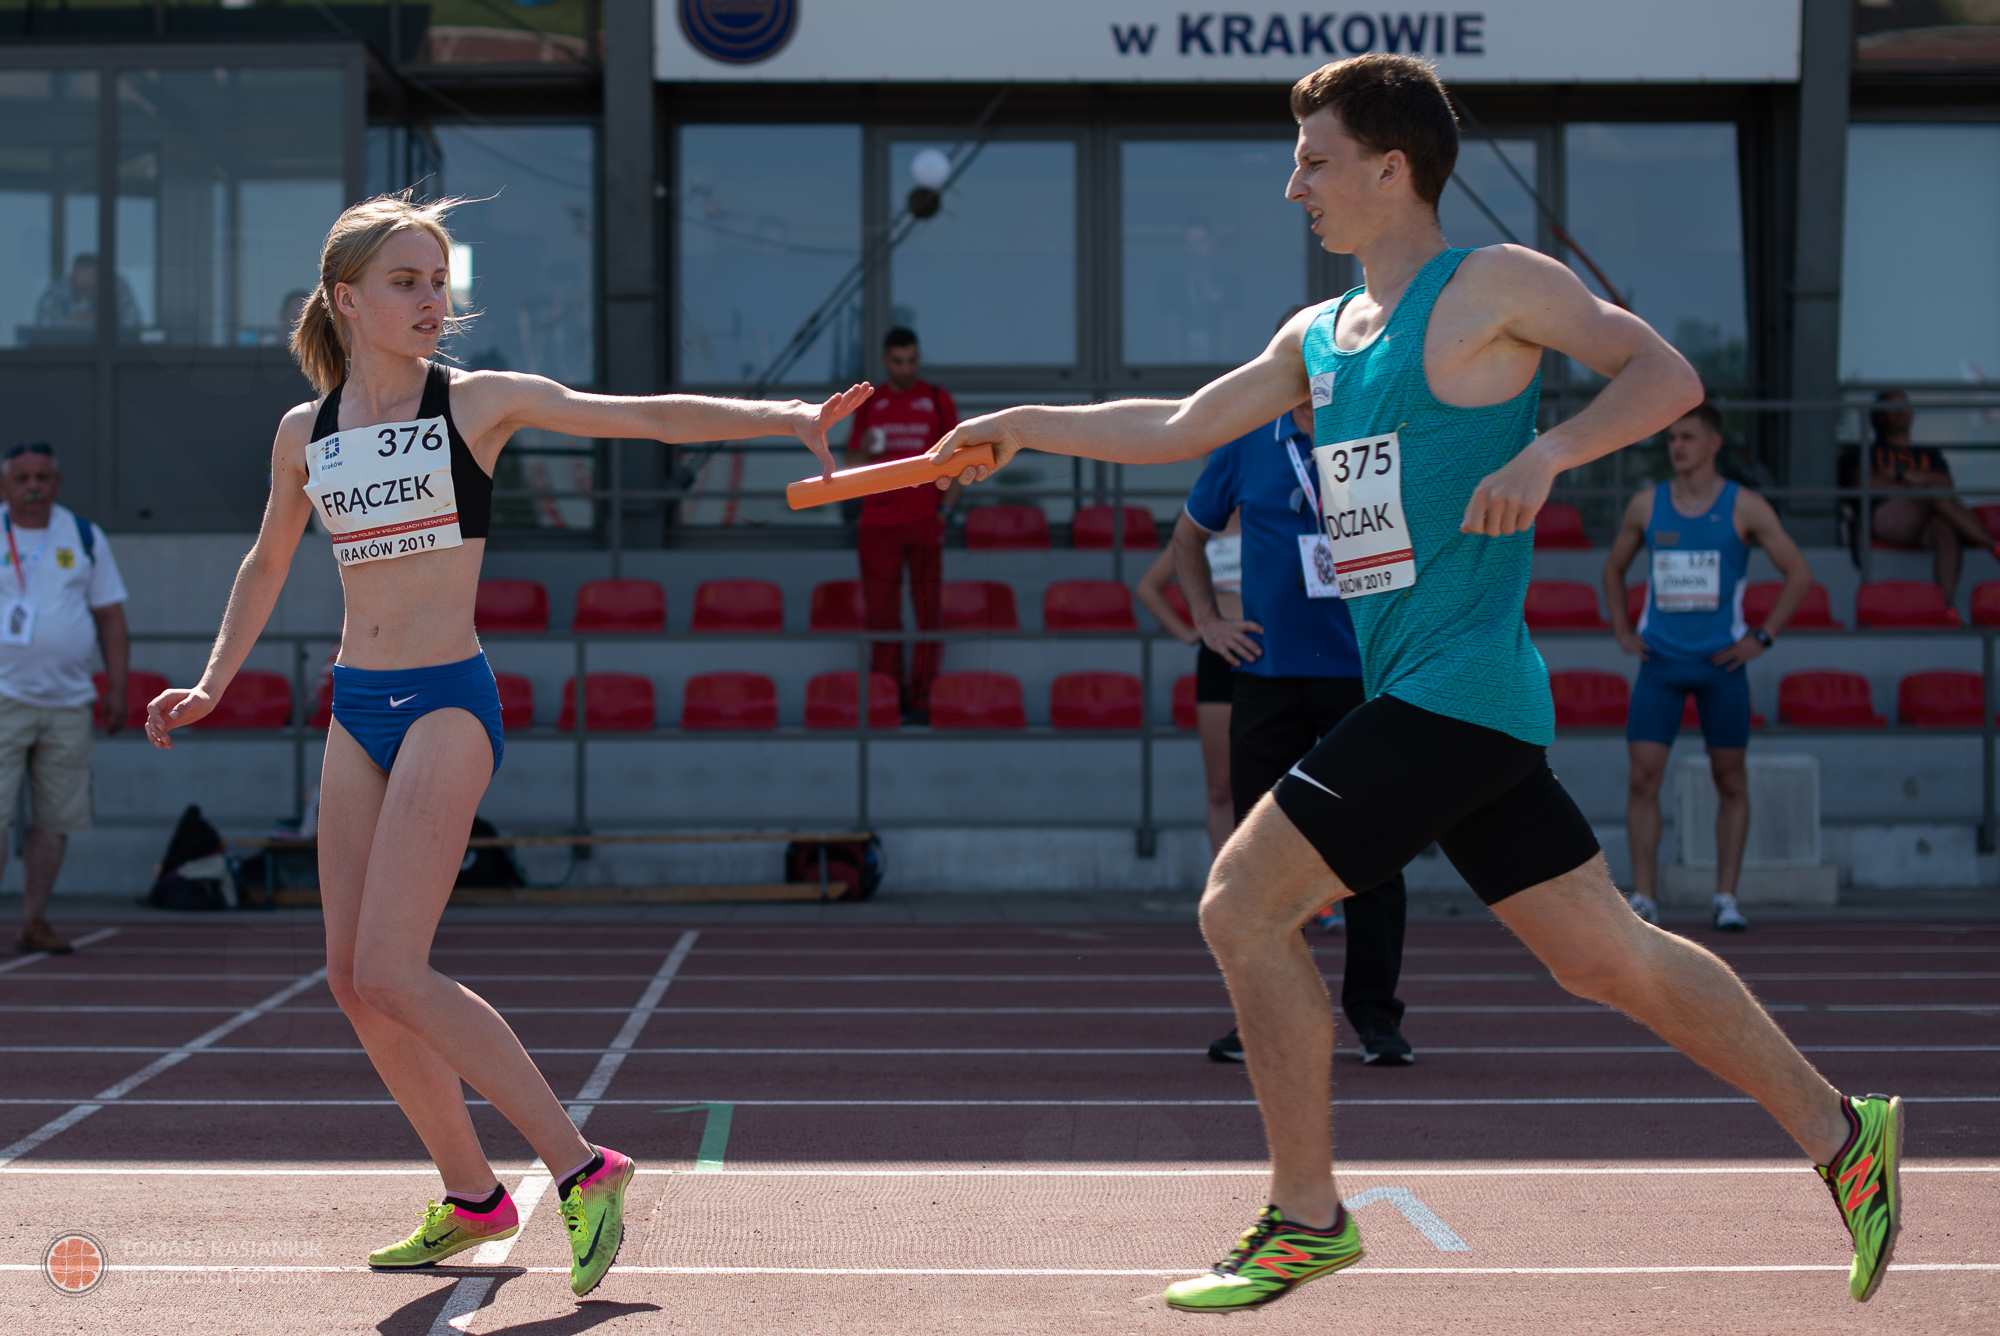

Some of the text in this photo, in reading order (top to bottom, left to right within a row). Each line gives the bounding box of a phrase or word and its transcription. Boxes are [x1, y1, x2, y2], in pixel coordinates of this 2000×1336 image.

[1110, 12, 1485, 55] w KRAKOWIE
[377, 423, 443, 457] 376
[321, 460, 343, 471] Kraków
[1332, 441, 1392, 483] 375
[321, 474, 435, 518] FRĄCZEK
[340, 534, 436, 562] KRAKÓW 2019
[1364, 571, 1392, 590] 2019
